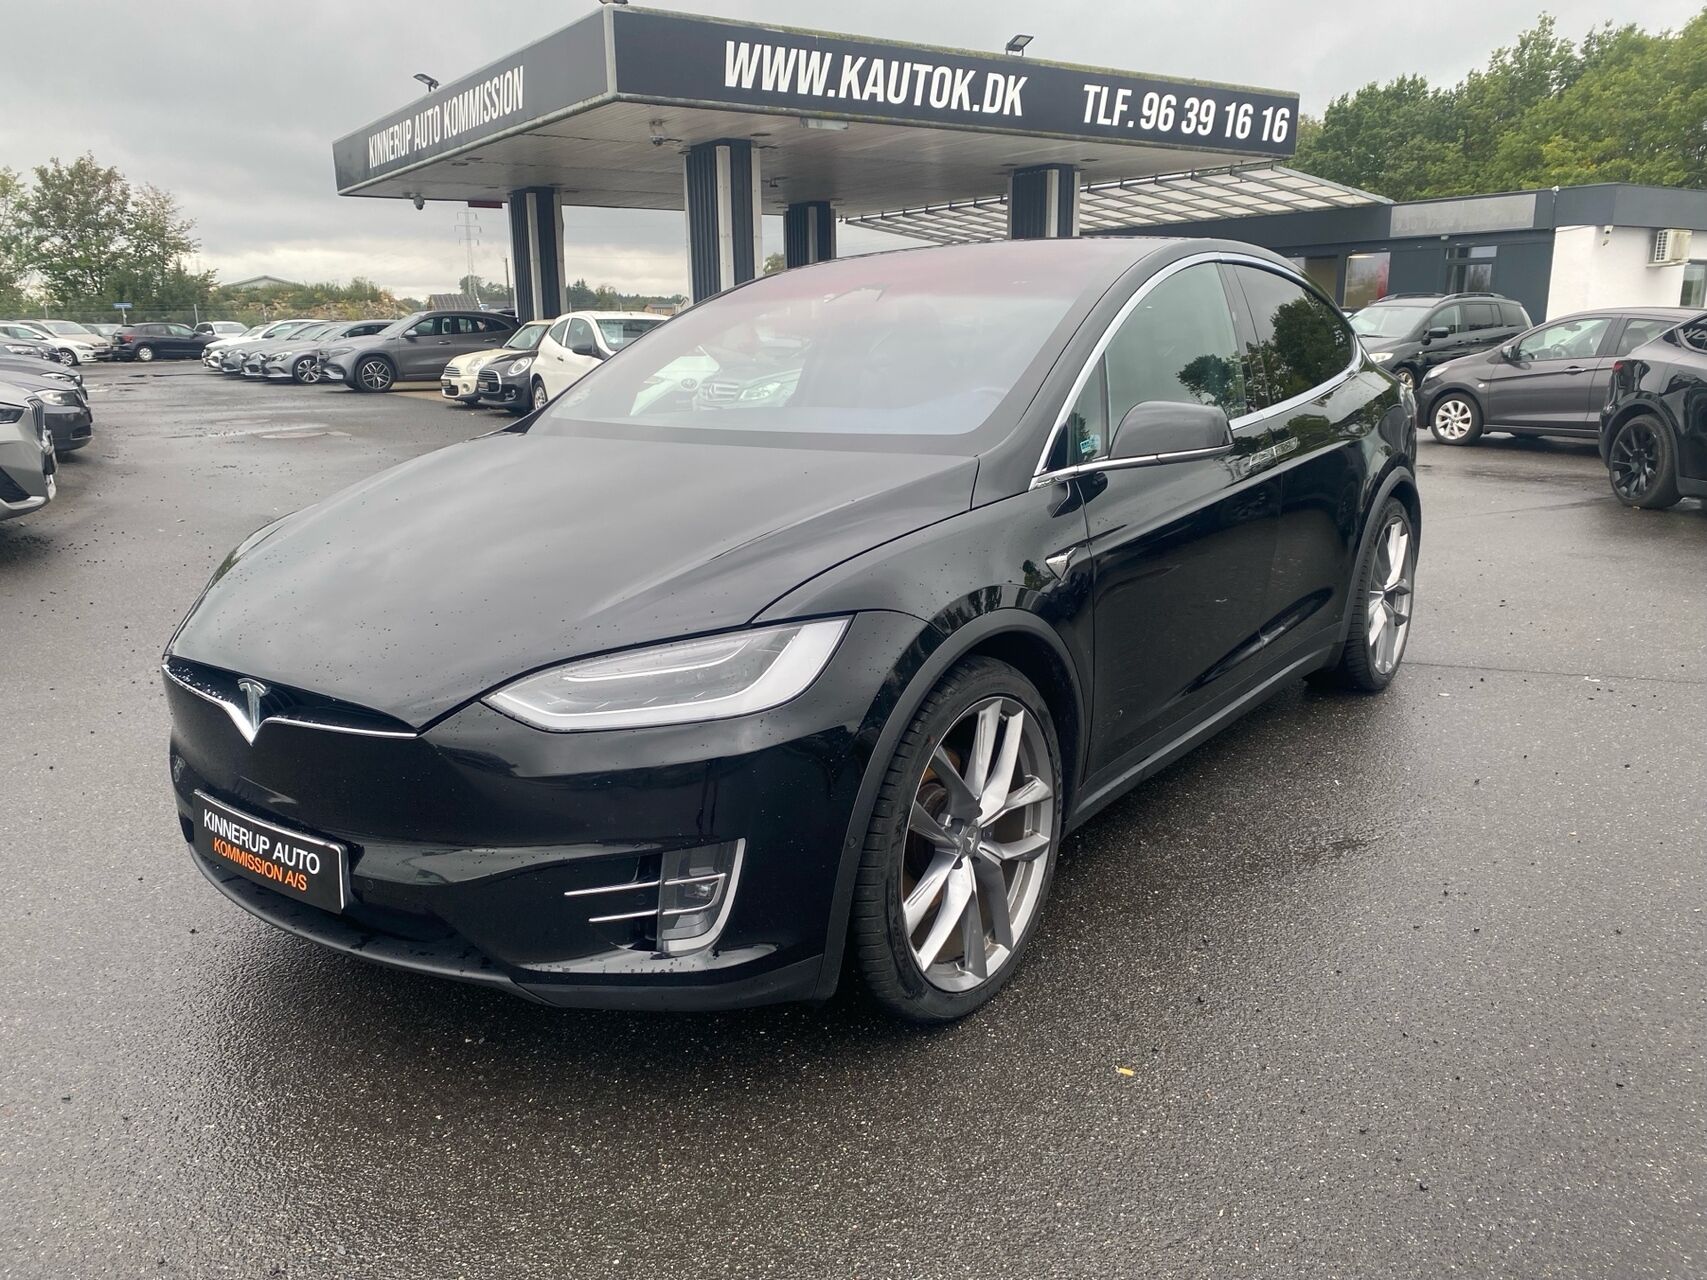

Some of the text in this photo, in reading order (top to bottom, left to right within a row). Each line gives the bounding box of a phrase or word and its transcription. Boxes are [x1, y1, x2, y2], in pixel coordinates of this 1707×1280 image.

[723, 40, 1029, 117] WWW.KAUTOK.DK
[368, 65, 524, 169] KINNERUP AUTO KOMMISSION
[1139, 91, 1177, 132] 96
[1180, 97, 1217, 136] 39
[1224, 102, 1254, 140] 16
[1261, 106, 1290, 143] 16
[203, 808, 321, 875] KINNERUP AUTO
[213, 837, 308, 892] KOMMISSION A/S
